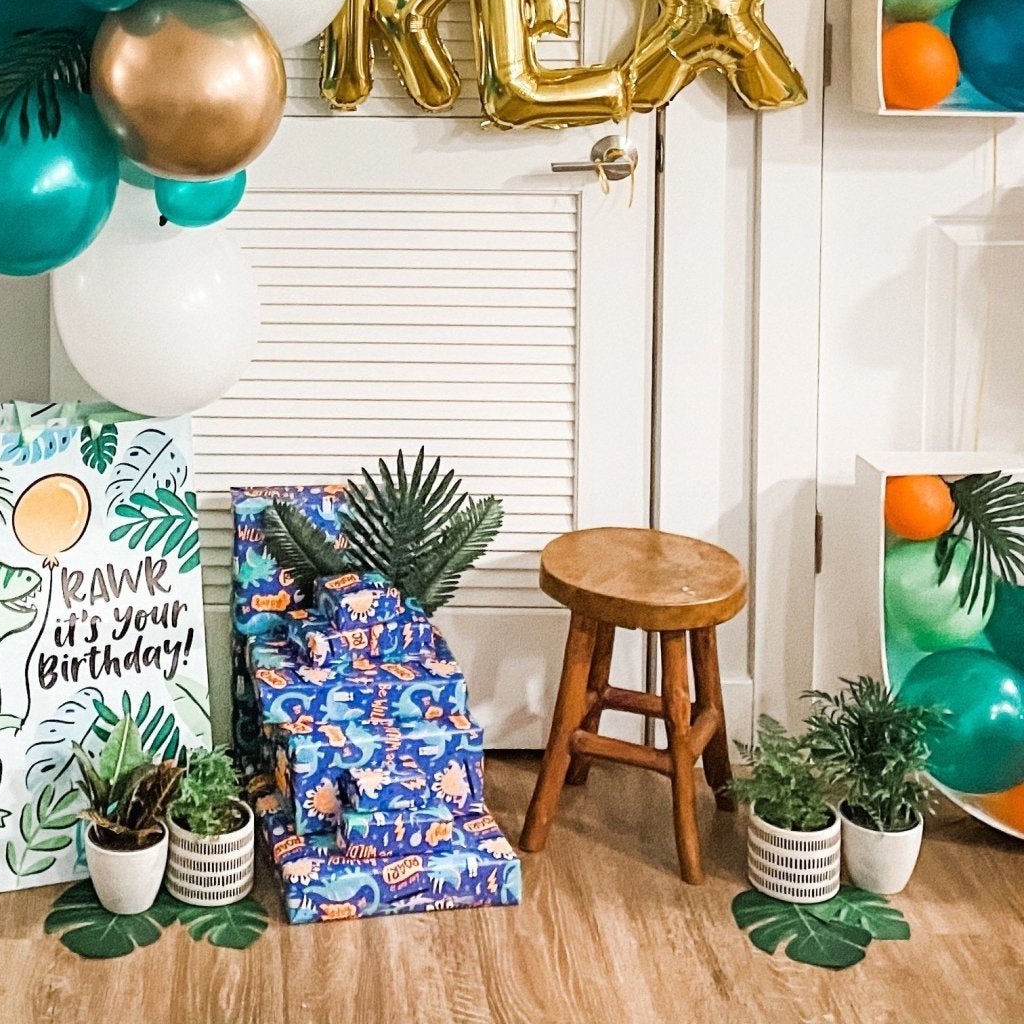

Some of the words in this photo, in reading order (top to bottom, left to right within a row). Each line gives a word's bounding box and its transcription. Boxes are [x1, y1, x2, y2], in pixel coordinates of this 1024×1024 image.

[60, 556, 172, 609] RAWR
[54, 609, 102, 648] it's
[112, 600, 188, 641] your
[37, 627, 194, 690] Birthday!
[386, 858, 420, 883] ROAR!
